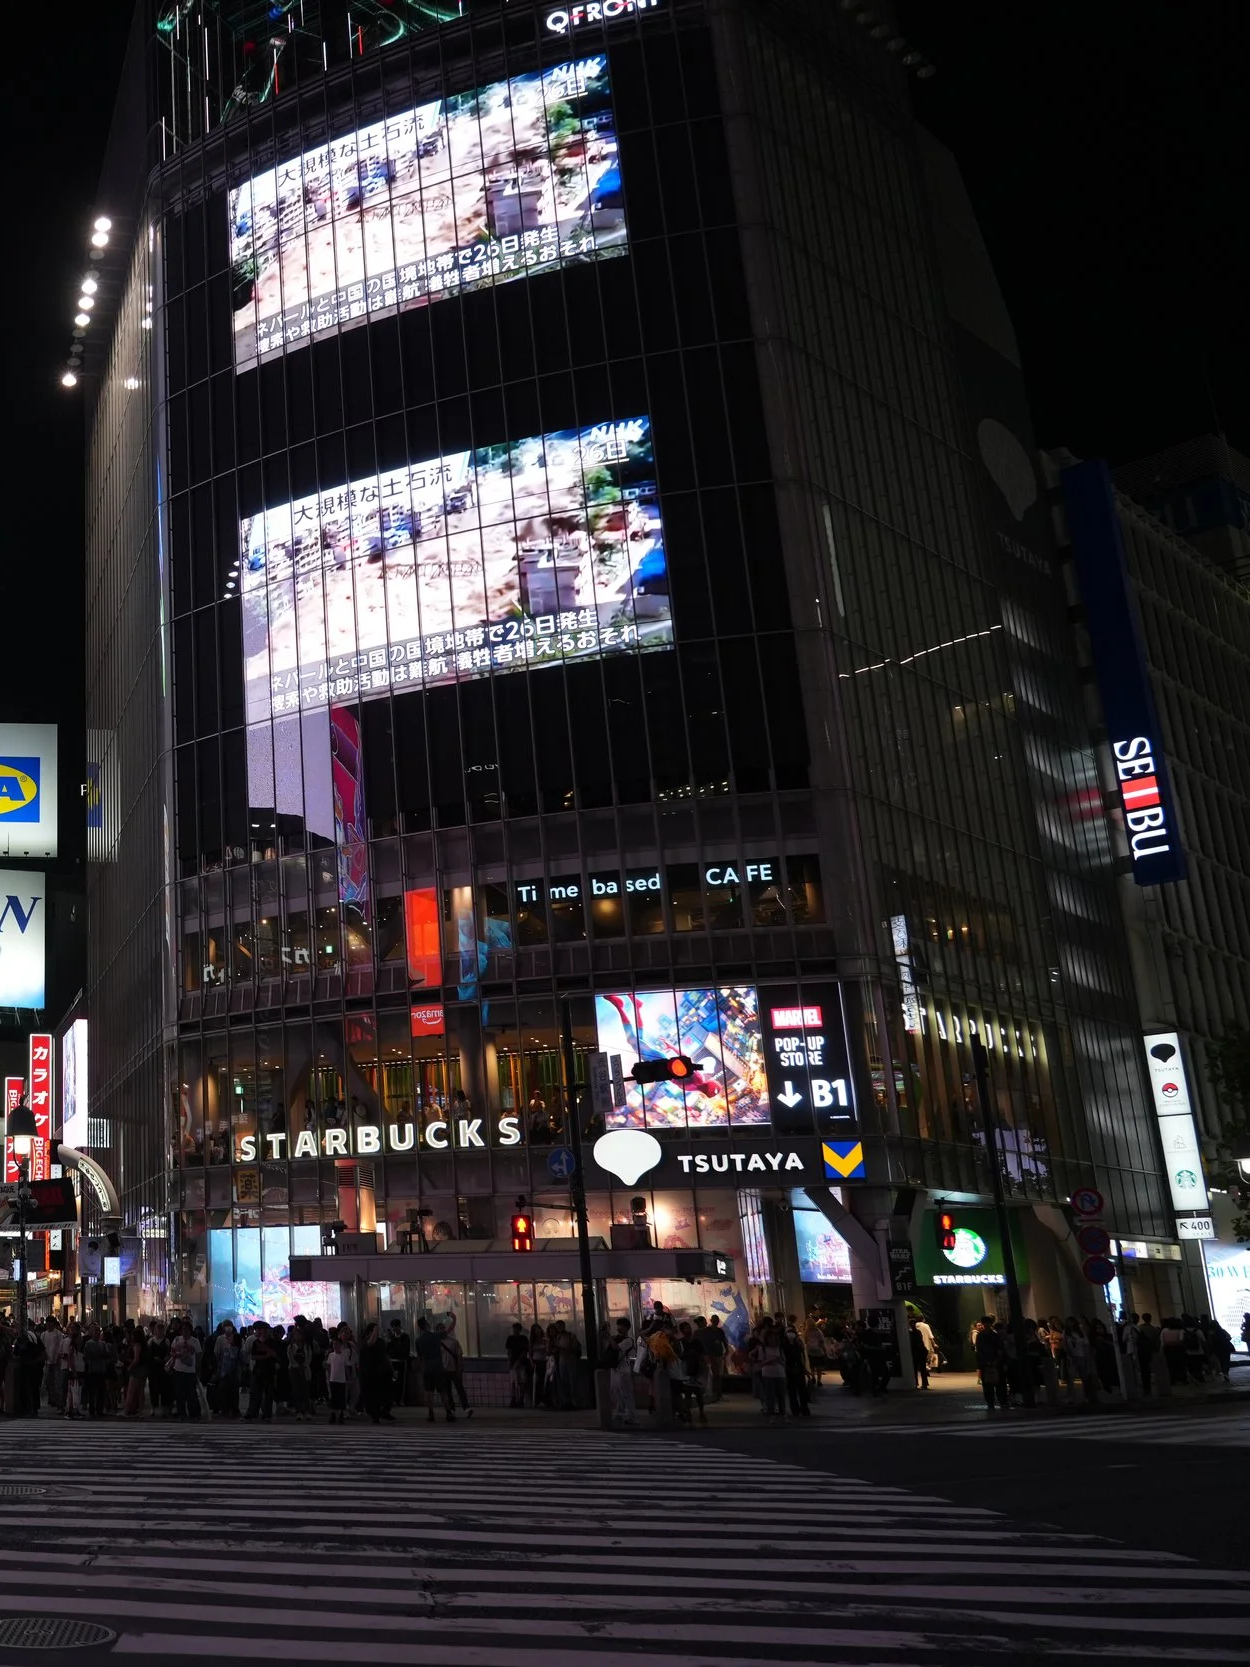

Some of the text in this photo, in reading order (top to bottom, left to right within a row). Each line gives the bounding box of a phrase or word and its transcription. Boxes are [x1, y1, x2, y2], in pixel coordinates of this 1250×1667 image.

[546, 0, 657, 34] QFRON
[550, 55, 606, 80] NHK
[535, 77, 587, 103] 26日
[279, 114, 427, 188] 大規模な土石流
[590, 418, 644, 442] NHK
[573, 438, 629, 466] 26日
[294, 463, 454, 526] 大規模な土石流
[270, 608, 599, 691] ネパールと中国の国境地帯で26日発生
[1113, 737, 1170, 861] SEIBU
[705, 864, 773, 886] CAFE
[773, 1009, 822, 1027] MARVEL
[774, 1035, 825, 1052] POP-UP
[780, 1051, 823, 1067] STORE
[32, 1047, 49, 1127] カラオケ
[812, 1079, 848, 1107] B1
[34, 1137, 44, 1158] BIG
[240, 1117, 521, 1161] STARBUCKS
[677, 1152, 804, 1173] TSUTAYA
[1191, 1221, 1211, 1231] 400
[933, 1274, 1005, 1285] STARBUCKS
